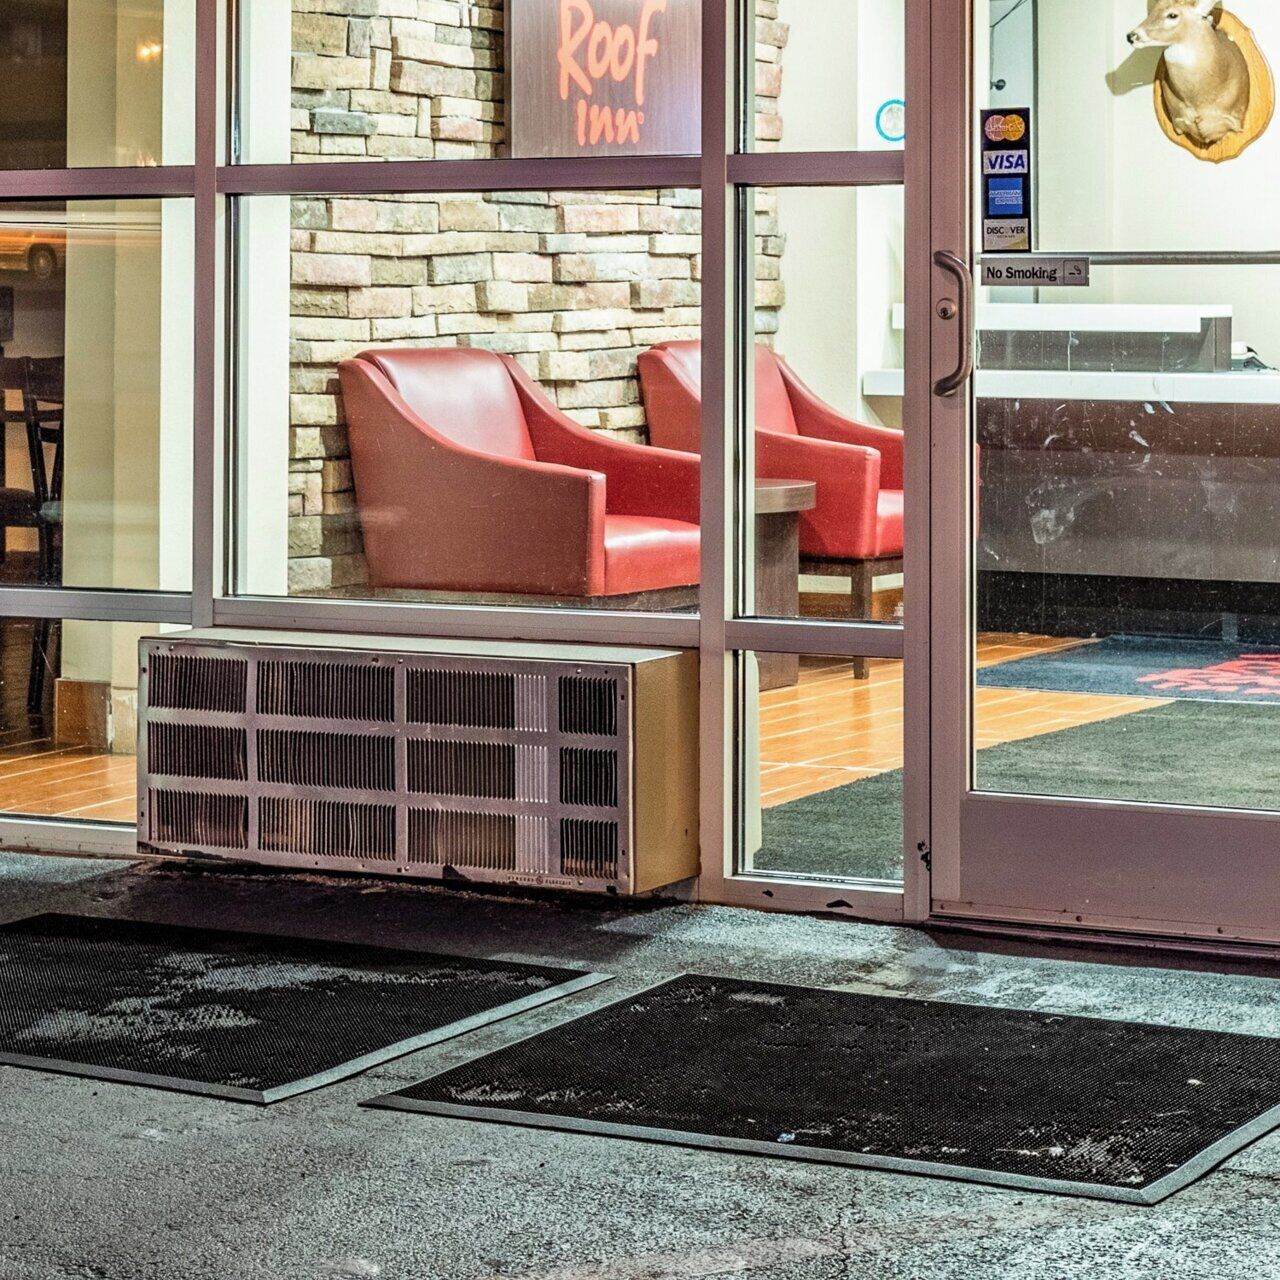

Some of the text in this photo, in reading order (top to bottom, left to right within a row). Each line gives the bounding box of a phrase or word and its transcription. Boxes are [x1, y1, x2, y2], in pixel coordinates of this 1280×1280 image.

[988, 154, 1025, 169] VISA
[986, 266, 1058, 282] No Smoking
